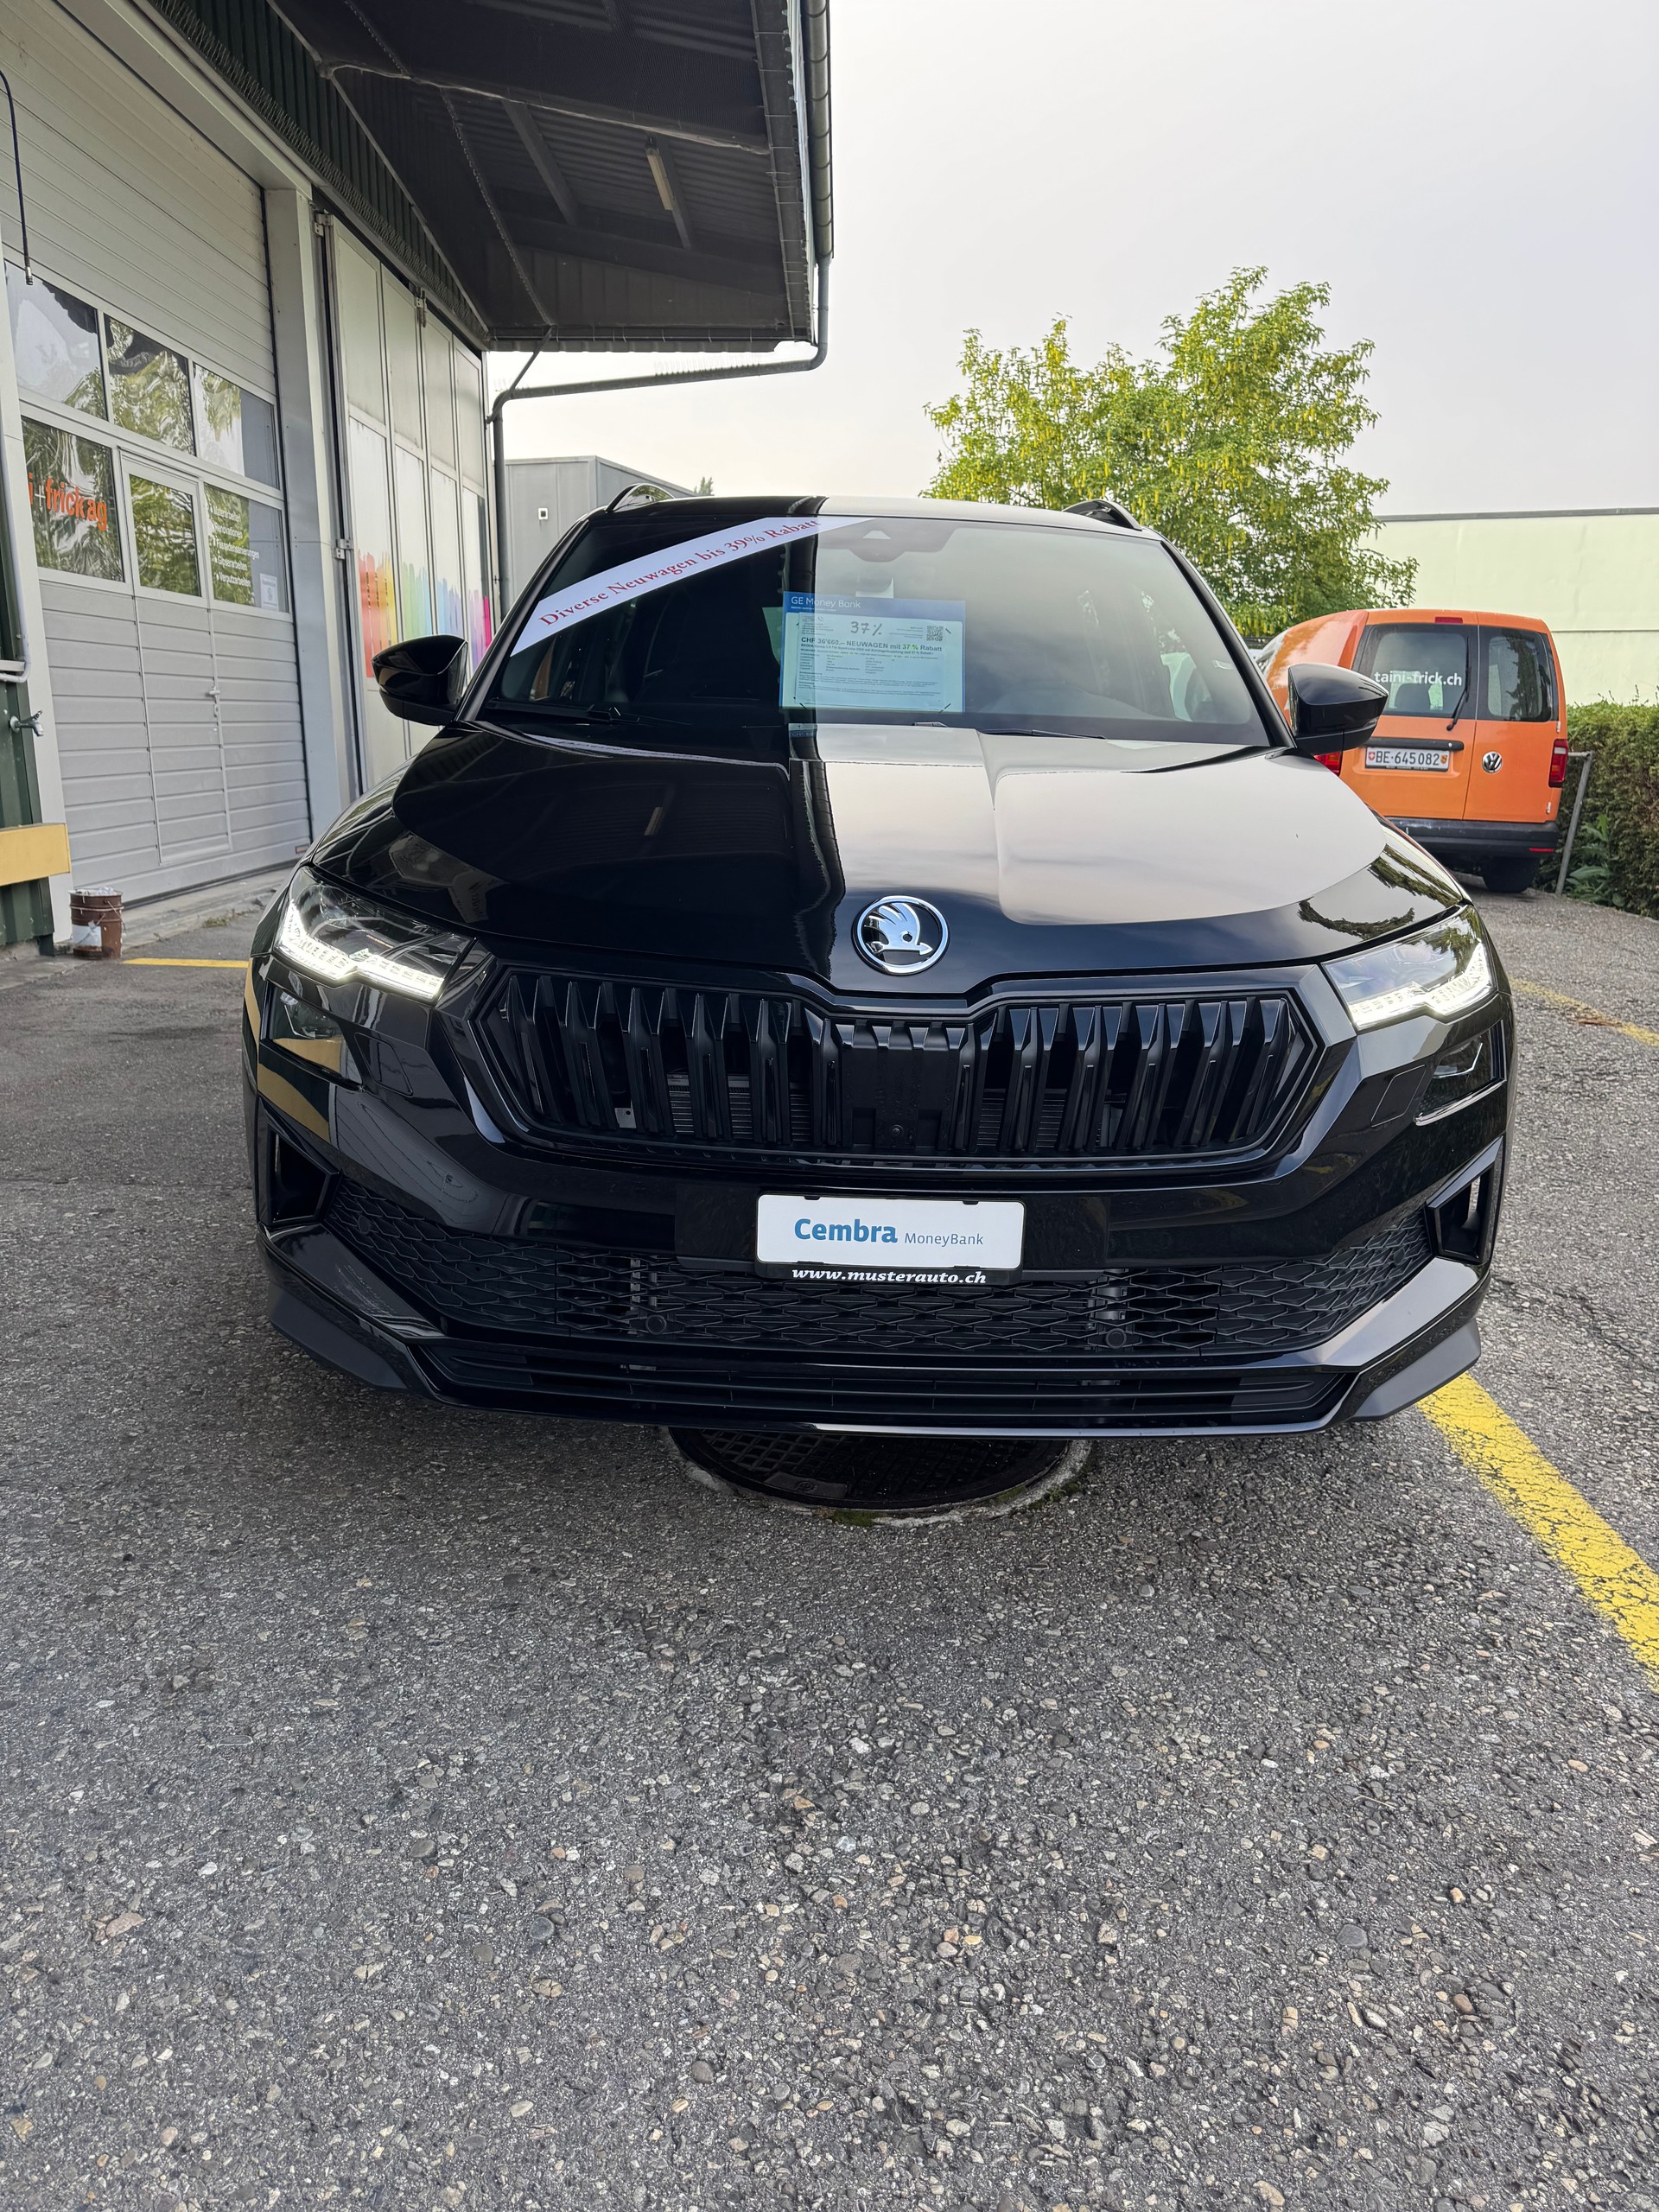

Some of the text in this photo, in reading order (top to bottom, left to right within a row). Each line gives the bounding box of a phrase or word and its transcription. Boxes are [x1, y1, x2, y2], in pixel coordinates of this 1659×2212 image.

[538, 519, 822, 626] Diverse Neuwagen bis 39% Rabatt
[791, 596, 804, 605] GE
[806, 597, 836, 609] Money
[838, 600, 861, 608] Bank
[846, 640, 888, 649] NEUWAGEN
[1374, 670, 1463, 686] taini-frick.ch
[794, 1217, 984, 1247] Cembra MoneyBank
[791, 1268, 987, 1284] www.musterauto.ch
